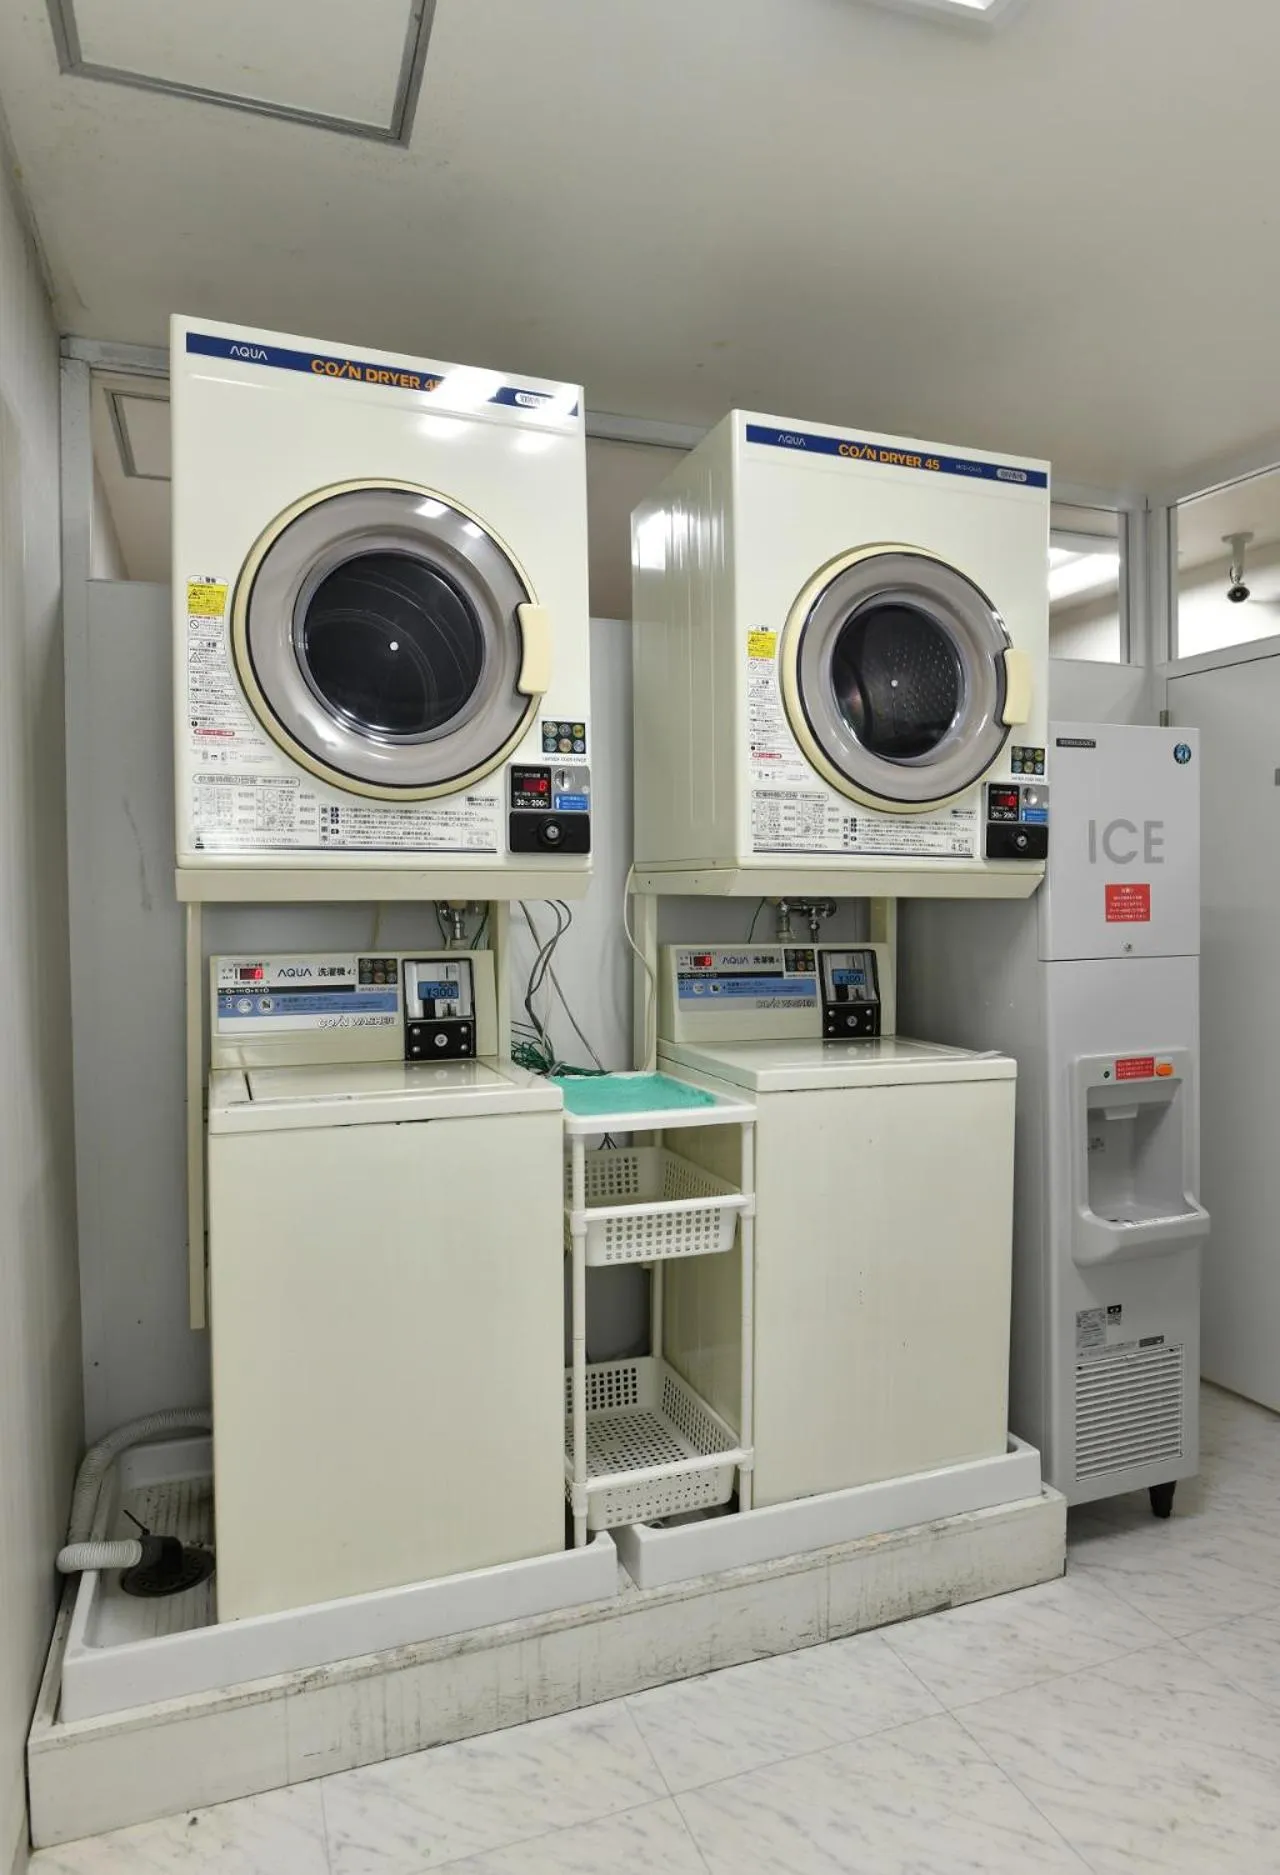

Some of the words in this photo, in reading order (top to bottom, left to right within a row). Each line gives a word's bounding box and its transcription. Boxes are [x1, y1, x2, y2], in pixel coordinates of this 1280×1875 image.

[230, 346, 268, 360] AQUA
[366, 368, 421, 390] DRYER
[778, 434, 806, 446] AQUA
[879, 451, 922, 467] DRYER
[925, 458, 940, 470] 45
[1089, 818, 1164, 865] ICE
[722, 956, 749, 965] AQUA
[277, 968, 312, 978] AQUA
